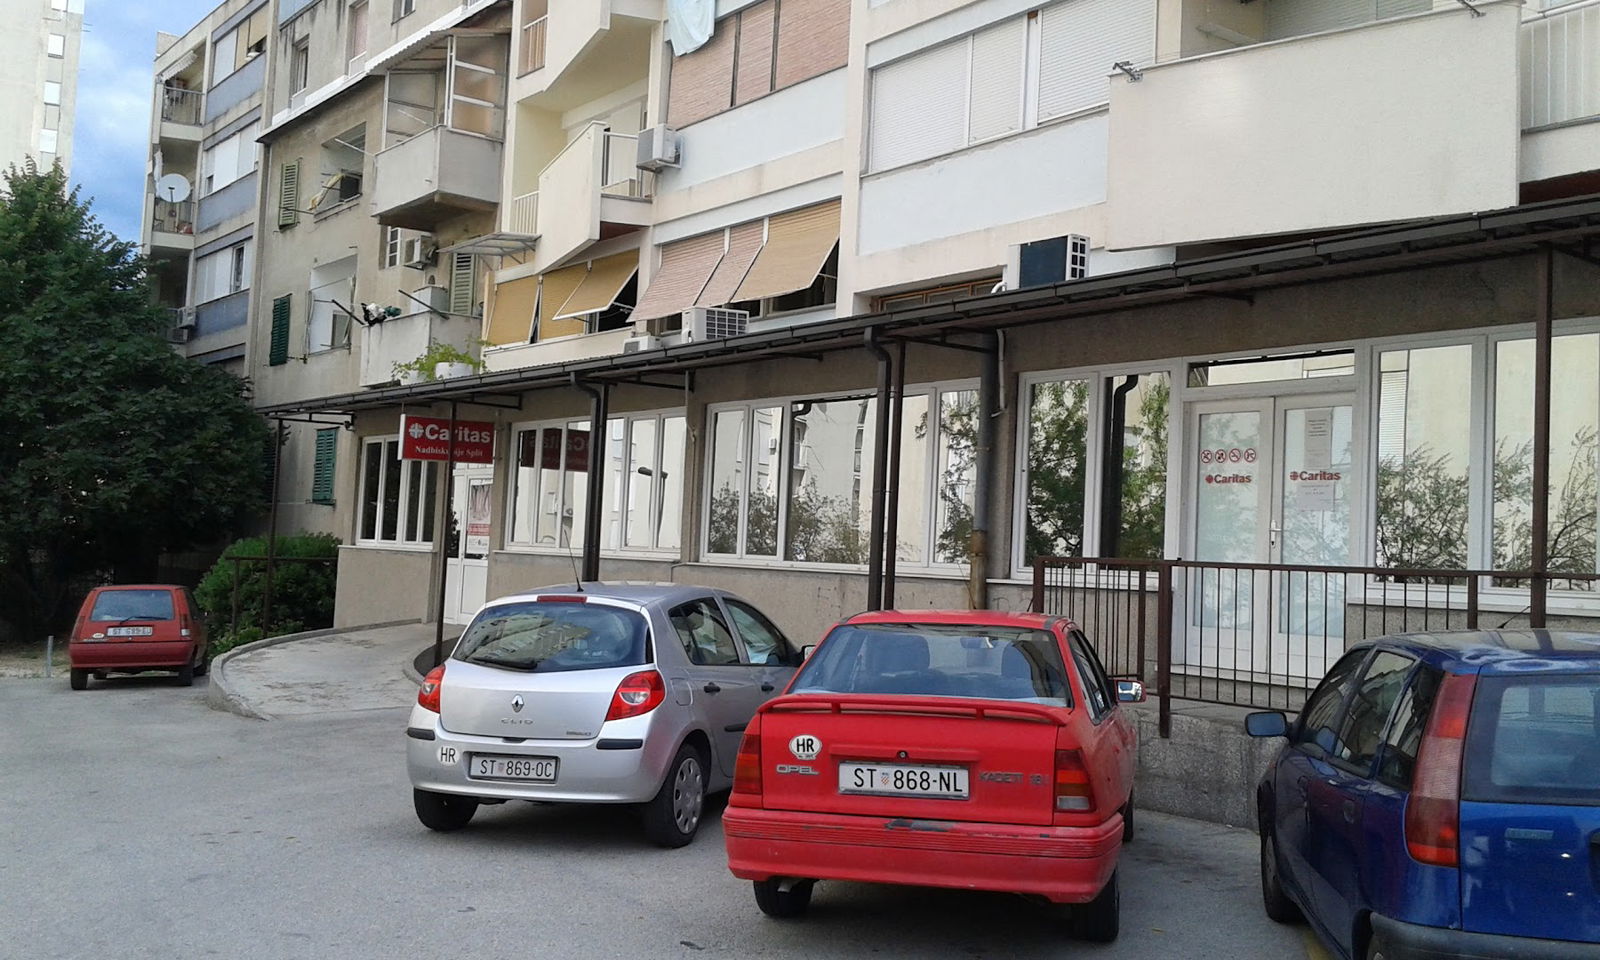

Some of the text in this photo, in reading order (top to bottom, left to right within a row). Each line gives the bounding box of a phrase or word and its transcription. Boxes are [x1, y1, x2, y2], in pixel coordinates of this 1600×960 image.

[425, 423, 490, 443] Caitas
[415, 446, 483, 458] Nadbiskije Split
[1214, 474, 1252, 484] Caritas
[1300, 470, 1341, 481] Caritas
[796, 738, 815, 752] HR
[440, 747, 456, 764] HR
[480, 759, 496, 775] ST
[777, 765, 819, 775] OPEL
[854, 768, 963, 792] ST 868-NL
